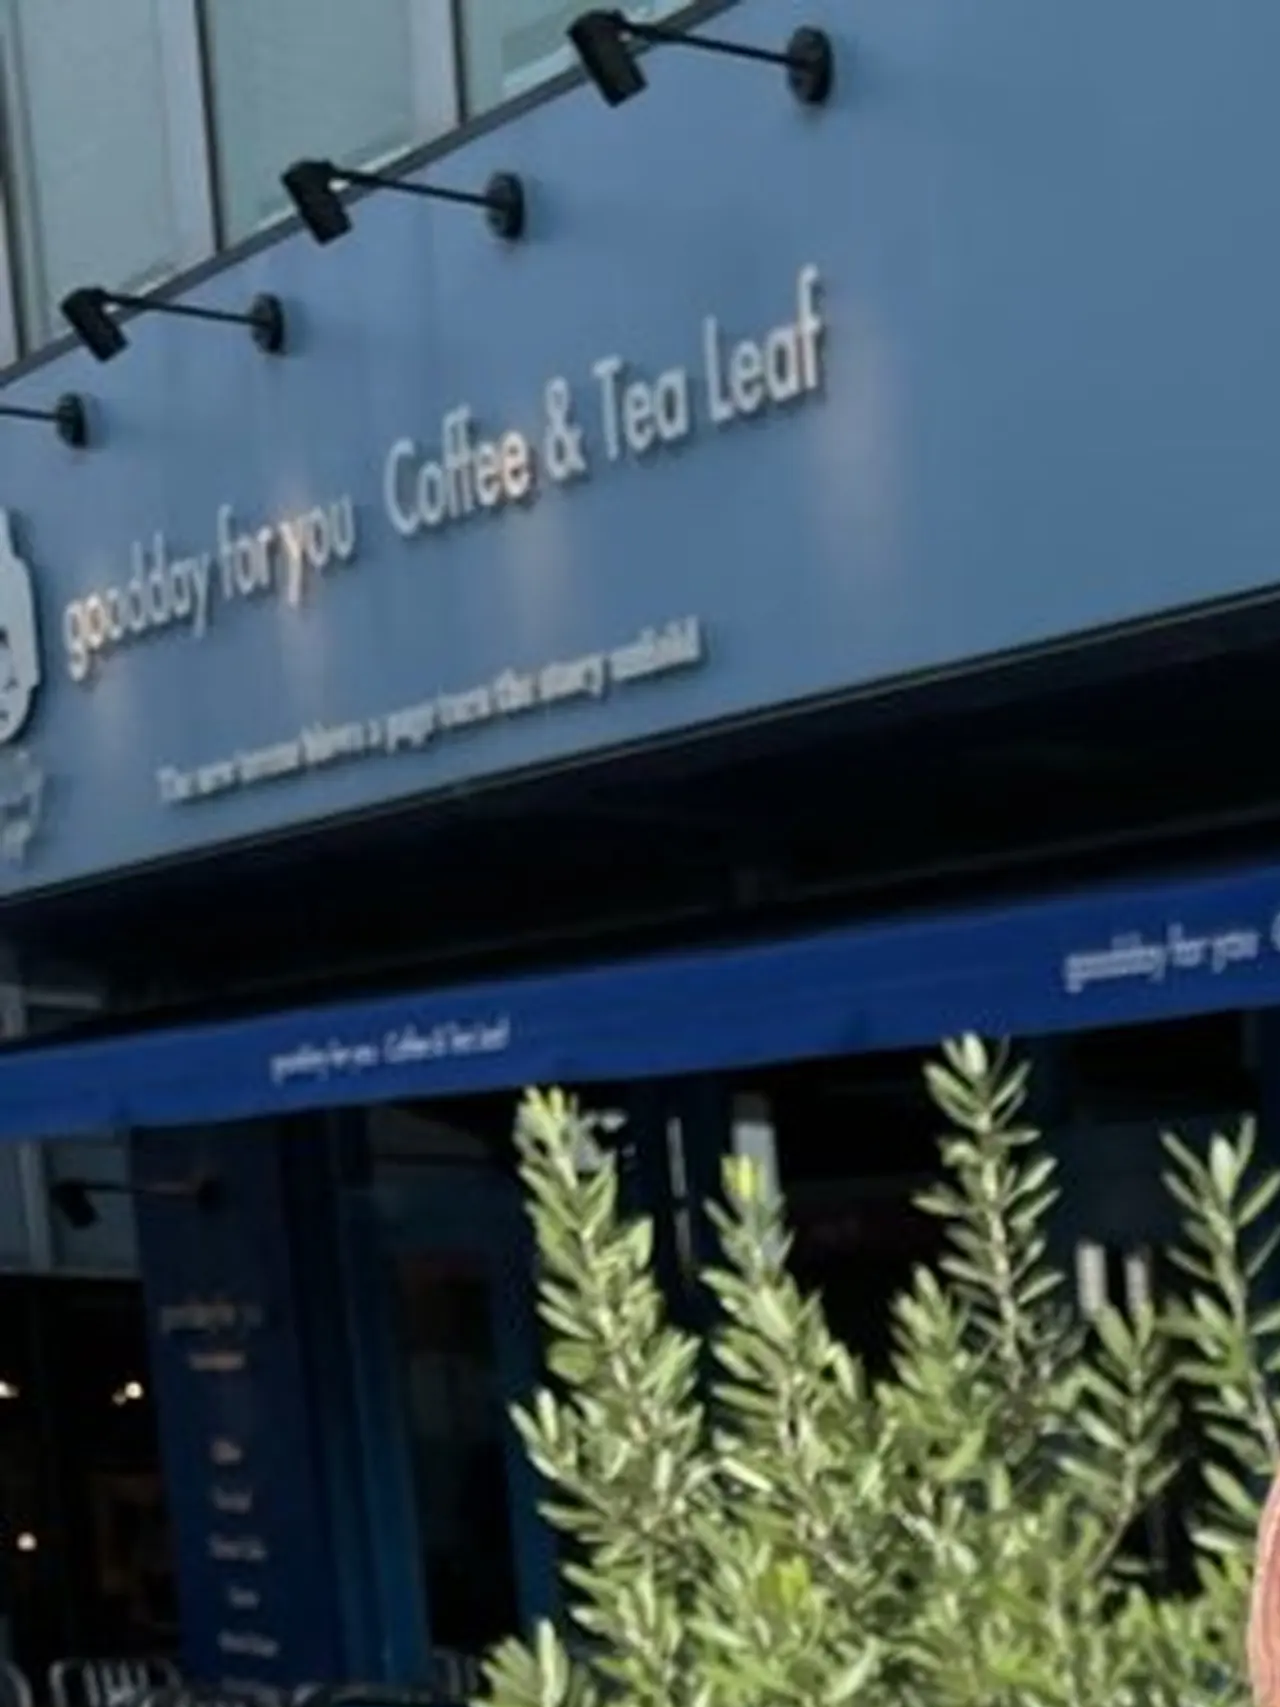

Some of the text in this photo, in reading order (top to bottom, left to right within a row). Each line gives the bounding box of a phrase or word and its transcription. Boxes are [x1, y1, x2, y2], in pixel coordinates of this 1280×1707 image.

[62, 262, 824, 683] goodday for you Coffee & Tea Leaf
